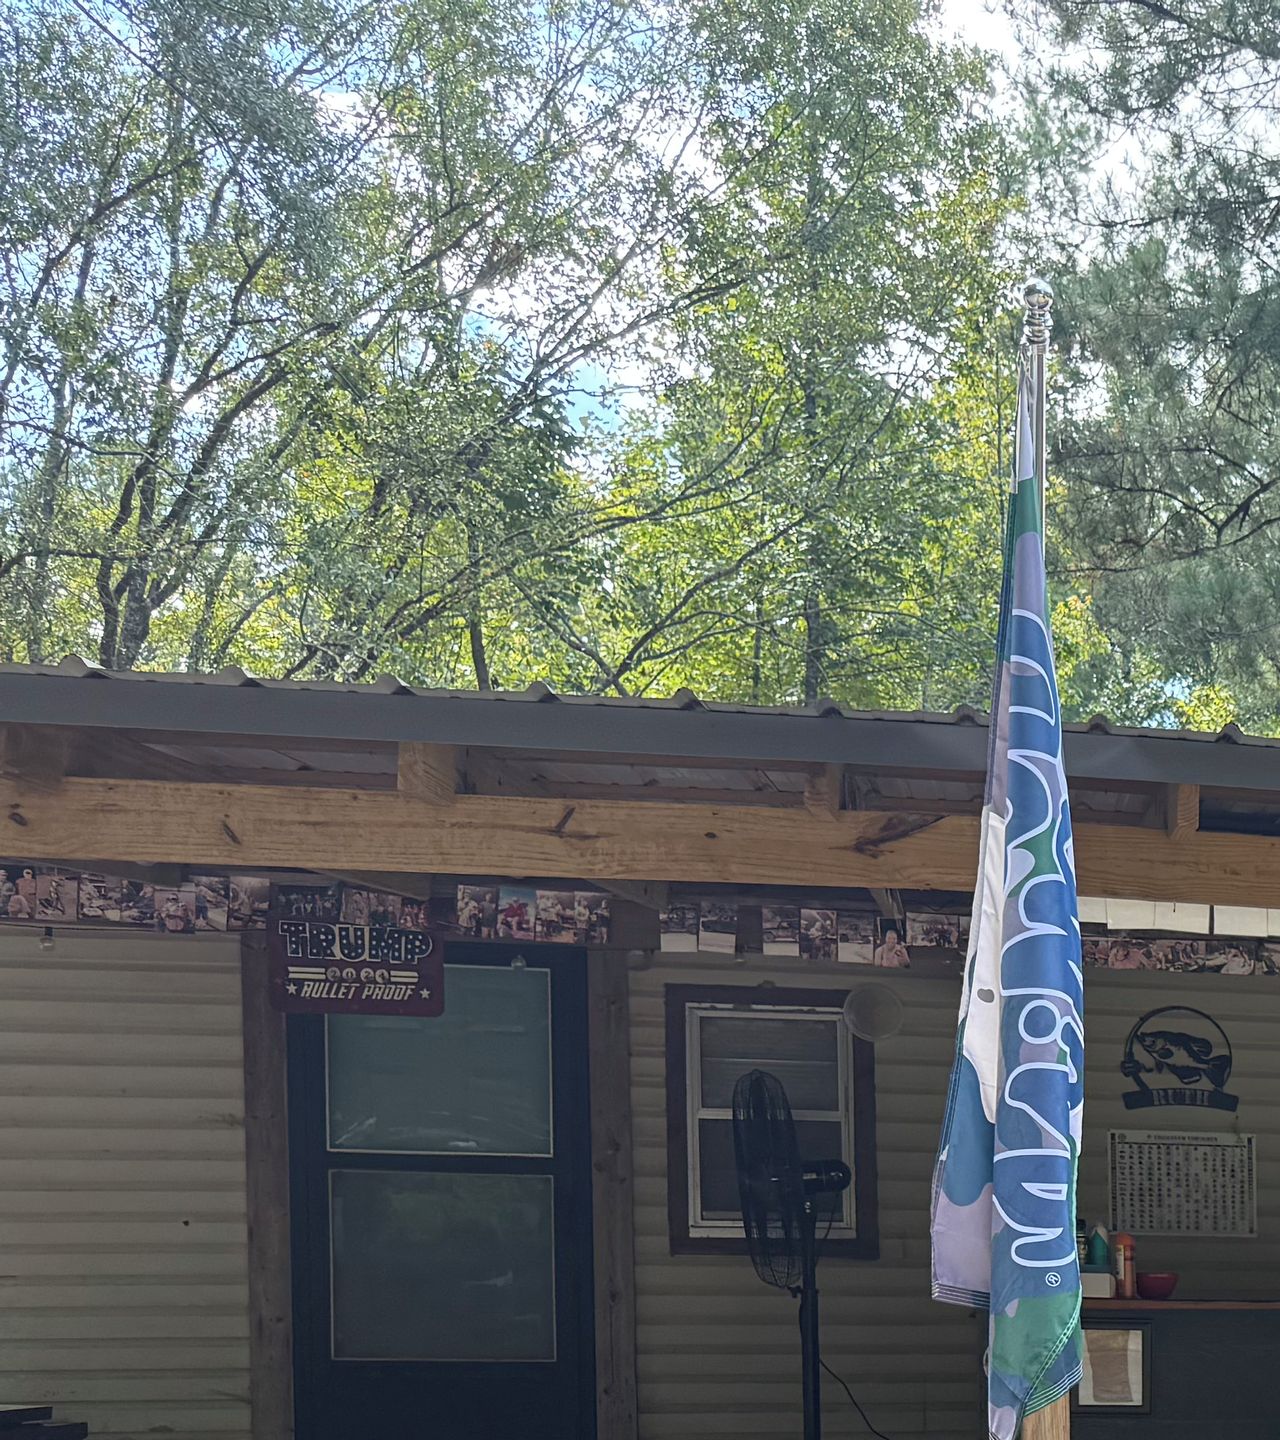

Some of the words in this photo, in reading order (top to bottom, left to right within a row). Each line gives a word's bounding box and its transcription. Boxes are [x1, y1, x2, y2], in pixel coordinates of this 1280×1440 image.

[279, 920, 433, 965] TRUMP
[362, 985, 417, 1000] PROOF
[1152, 1089, 1209, 1105] RUTH
